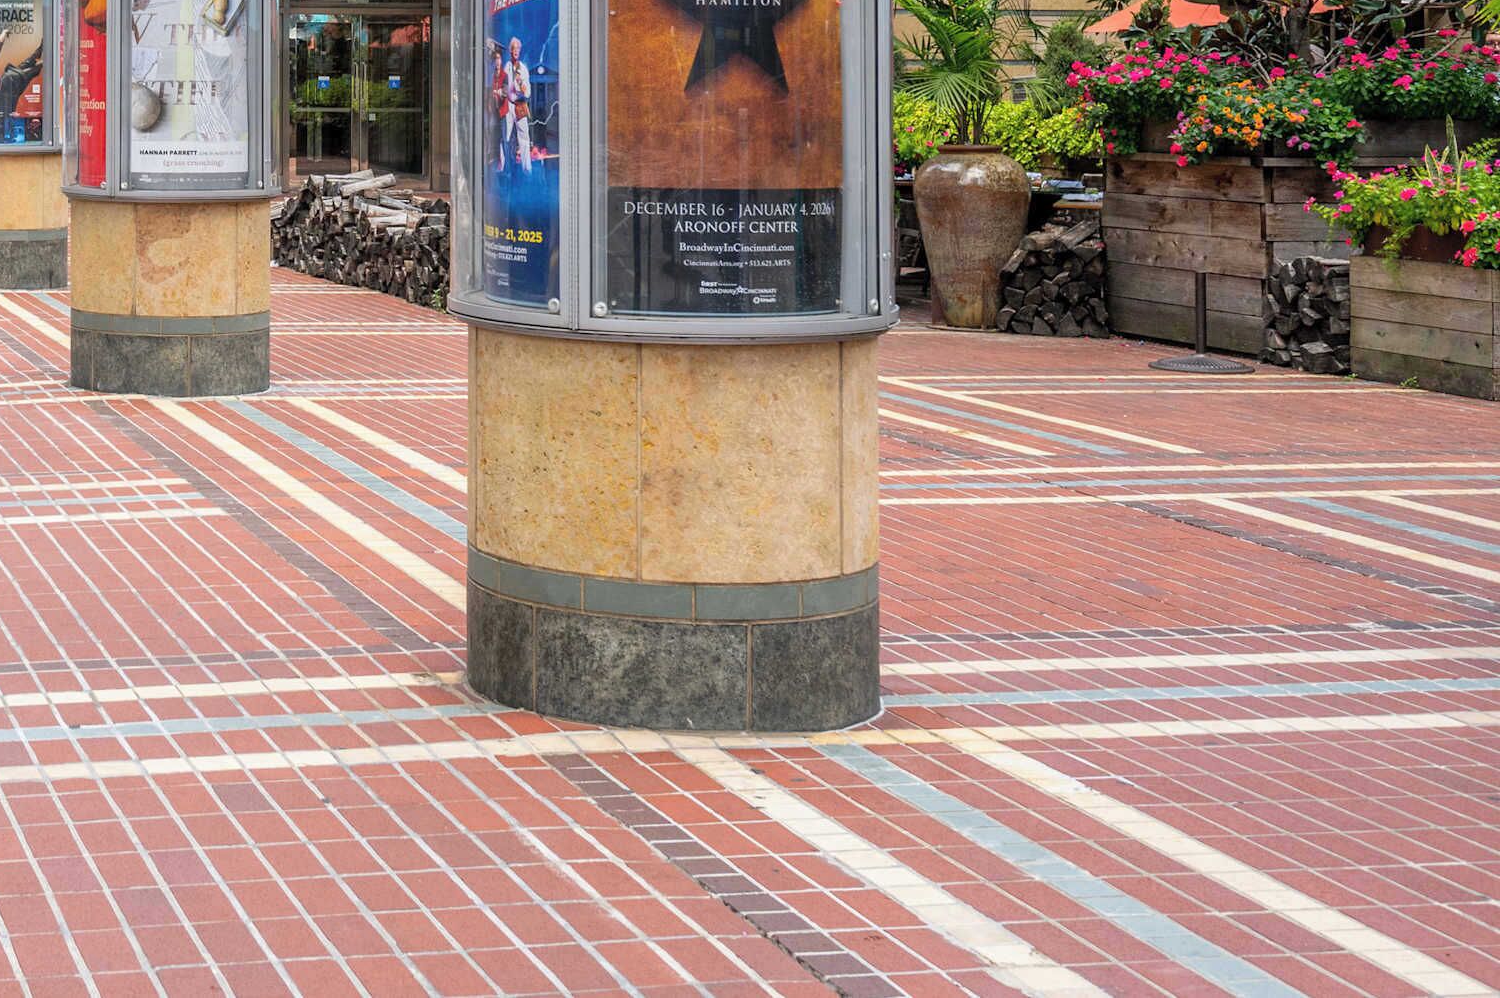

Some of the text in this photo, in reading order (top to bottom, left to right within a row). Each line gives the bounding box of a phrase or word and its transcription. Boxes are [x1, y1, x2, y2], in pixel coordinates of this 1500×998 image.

[624, 201, 708, 216] DECEMBER
[712, 204, 725, 216] 16
[738, 203, 797, 218] JANUARY
[810, 203, 831, 216] 2026
[674, 221, 799, 234] ARONOFF CENTER
[517, 230, 543, 243] 2025
[679, 242, 795, 253] BroadwayInCincinnati.com
[683, 259, 792, 268] CincinnatiArts.org 513.621.ARTS
